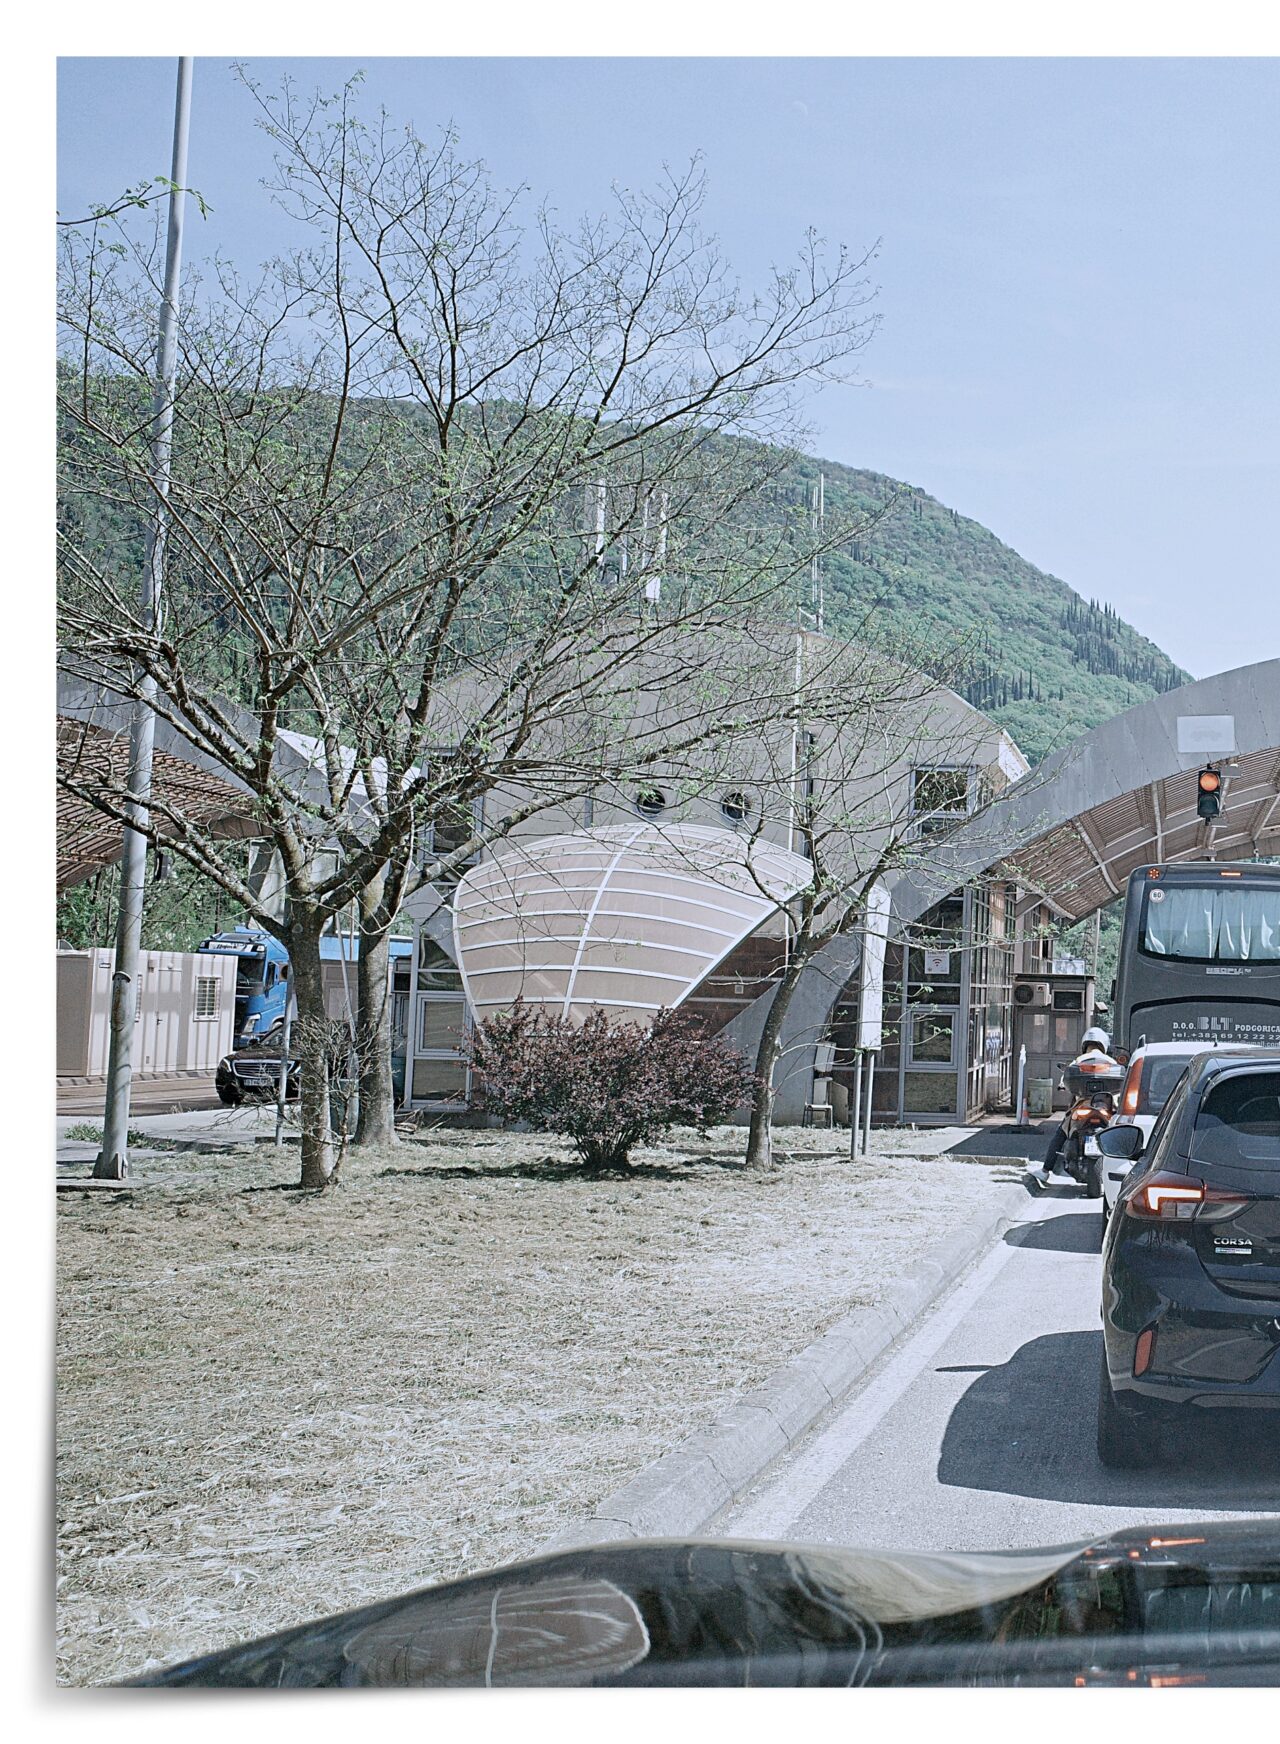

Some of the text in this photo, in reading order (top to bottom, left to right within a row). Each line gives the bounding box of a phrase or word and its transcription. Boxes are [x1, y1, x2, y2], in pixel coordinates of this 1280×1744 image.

[1172, 1016, 1280, 1033] D.O.O. BLT PODGORICA
[1213, 1237, 1253, 1246] CORSA
